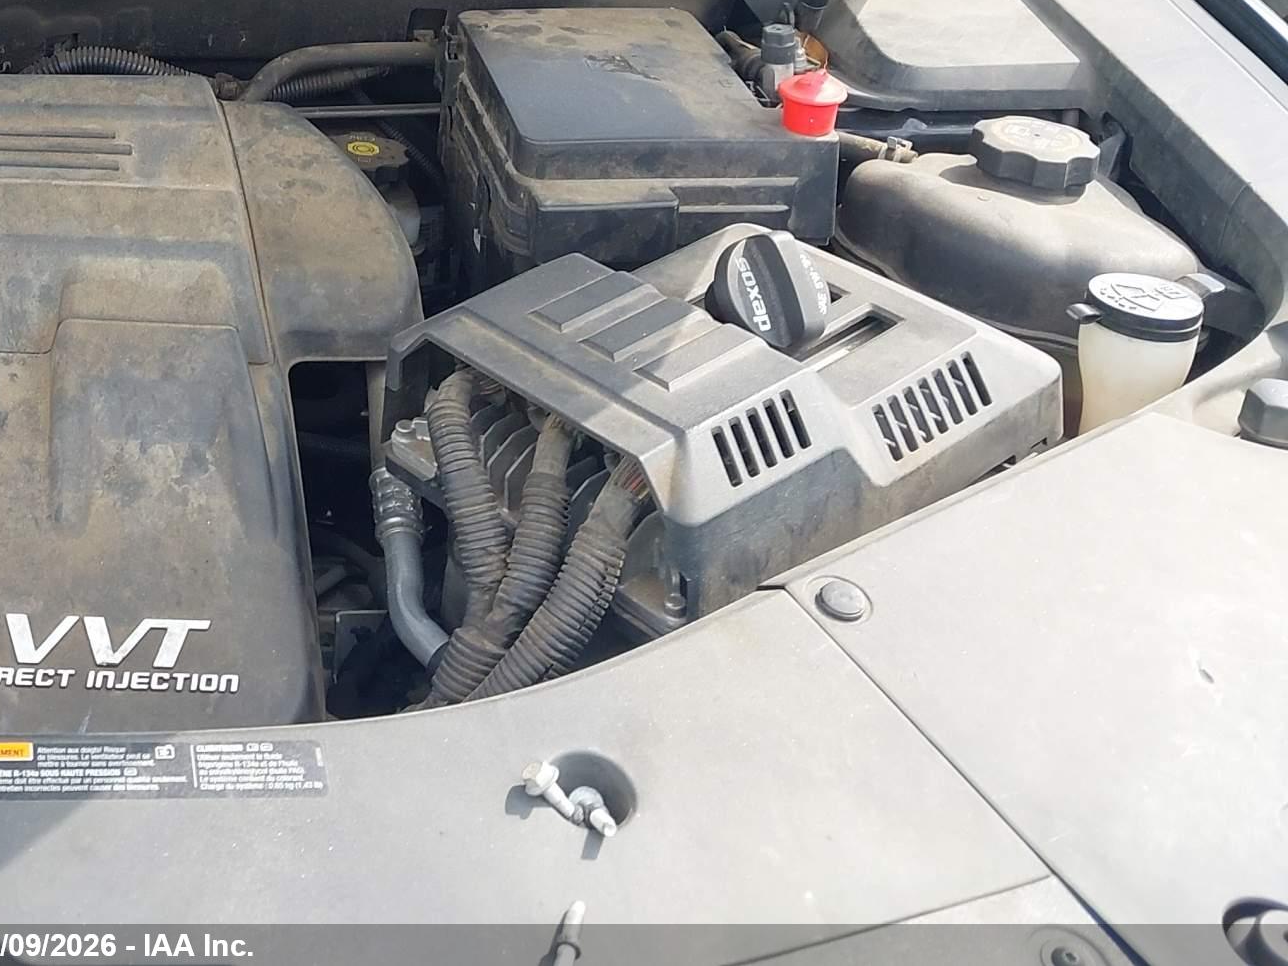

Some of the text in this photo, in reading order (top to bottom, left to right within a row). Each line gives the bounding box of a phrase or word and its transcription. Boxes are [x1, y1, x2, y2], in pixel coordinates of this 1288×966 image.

[735, 257, 771, 332] dexos
[4, 612, 212, 668] VVT
[86, 669, 239, 694] INJECTION
